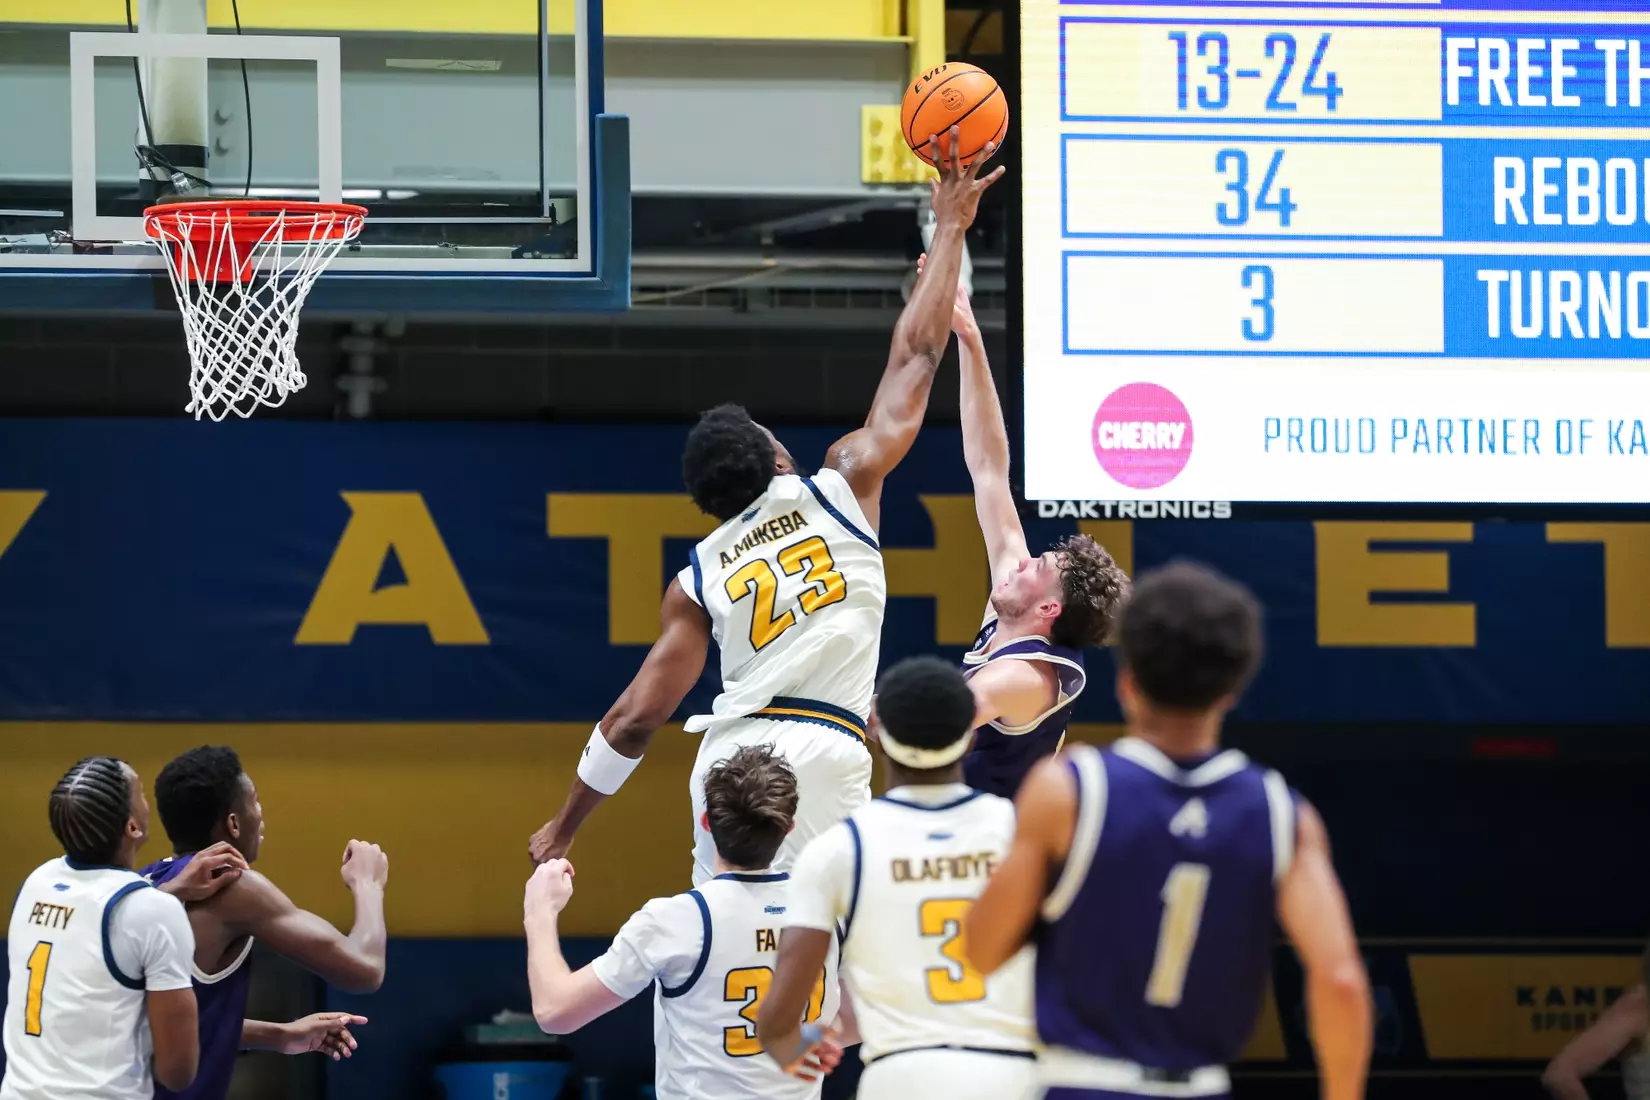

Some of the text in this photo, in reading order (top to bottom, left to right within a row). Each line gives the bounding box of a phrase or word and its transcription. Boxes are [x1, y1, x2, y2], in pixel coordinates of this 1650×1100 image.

[1168, 30, 1344, 112] 13-24
[1446, 37, 1581, 107] FREE
[1215, 148, 1298, 228] 34
[1494, 156, 1650, 226] REBO
[1240, 264, 1275, 343] 3
[1098, 421, 1186, 450] CHERRY
[1264, 417, 1649, 456] PROUD PARTNER OF KA
[718, 510, 809, 570] A.MUKEBA
[1038, 500, 1232, 519] DAKTRONICS
[724, 535, 847, 653] 23
[28, 902, 75, 930] PETTY
[918, 897, 988, 1004] 3
[1145, 862, 1211, 1008] 1
[25, 941, 53, 1037] 1
